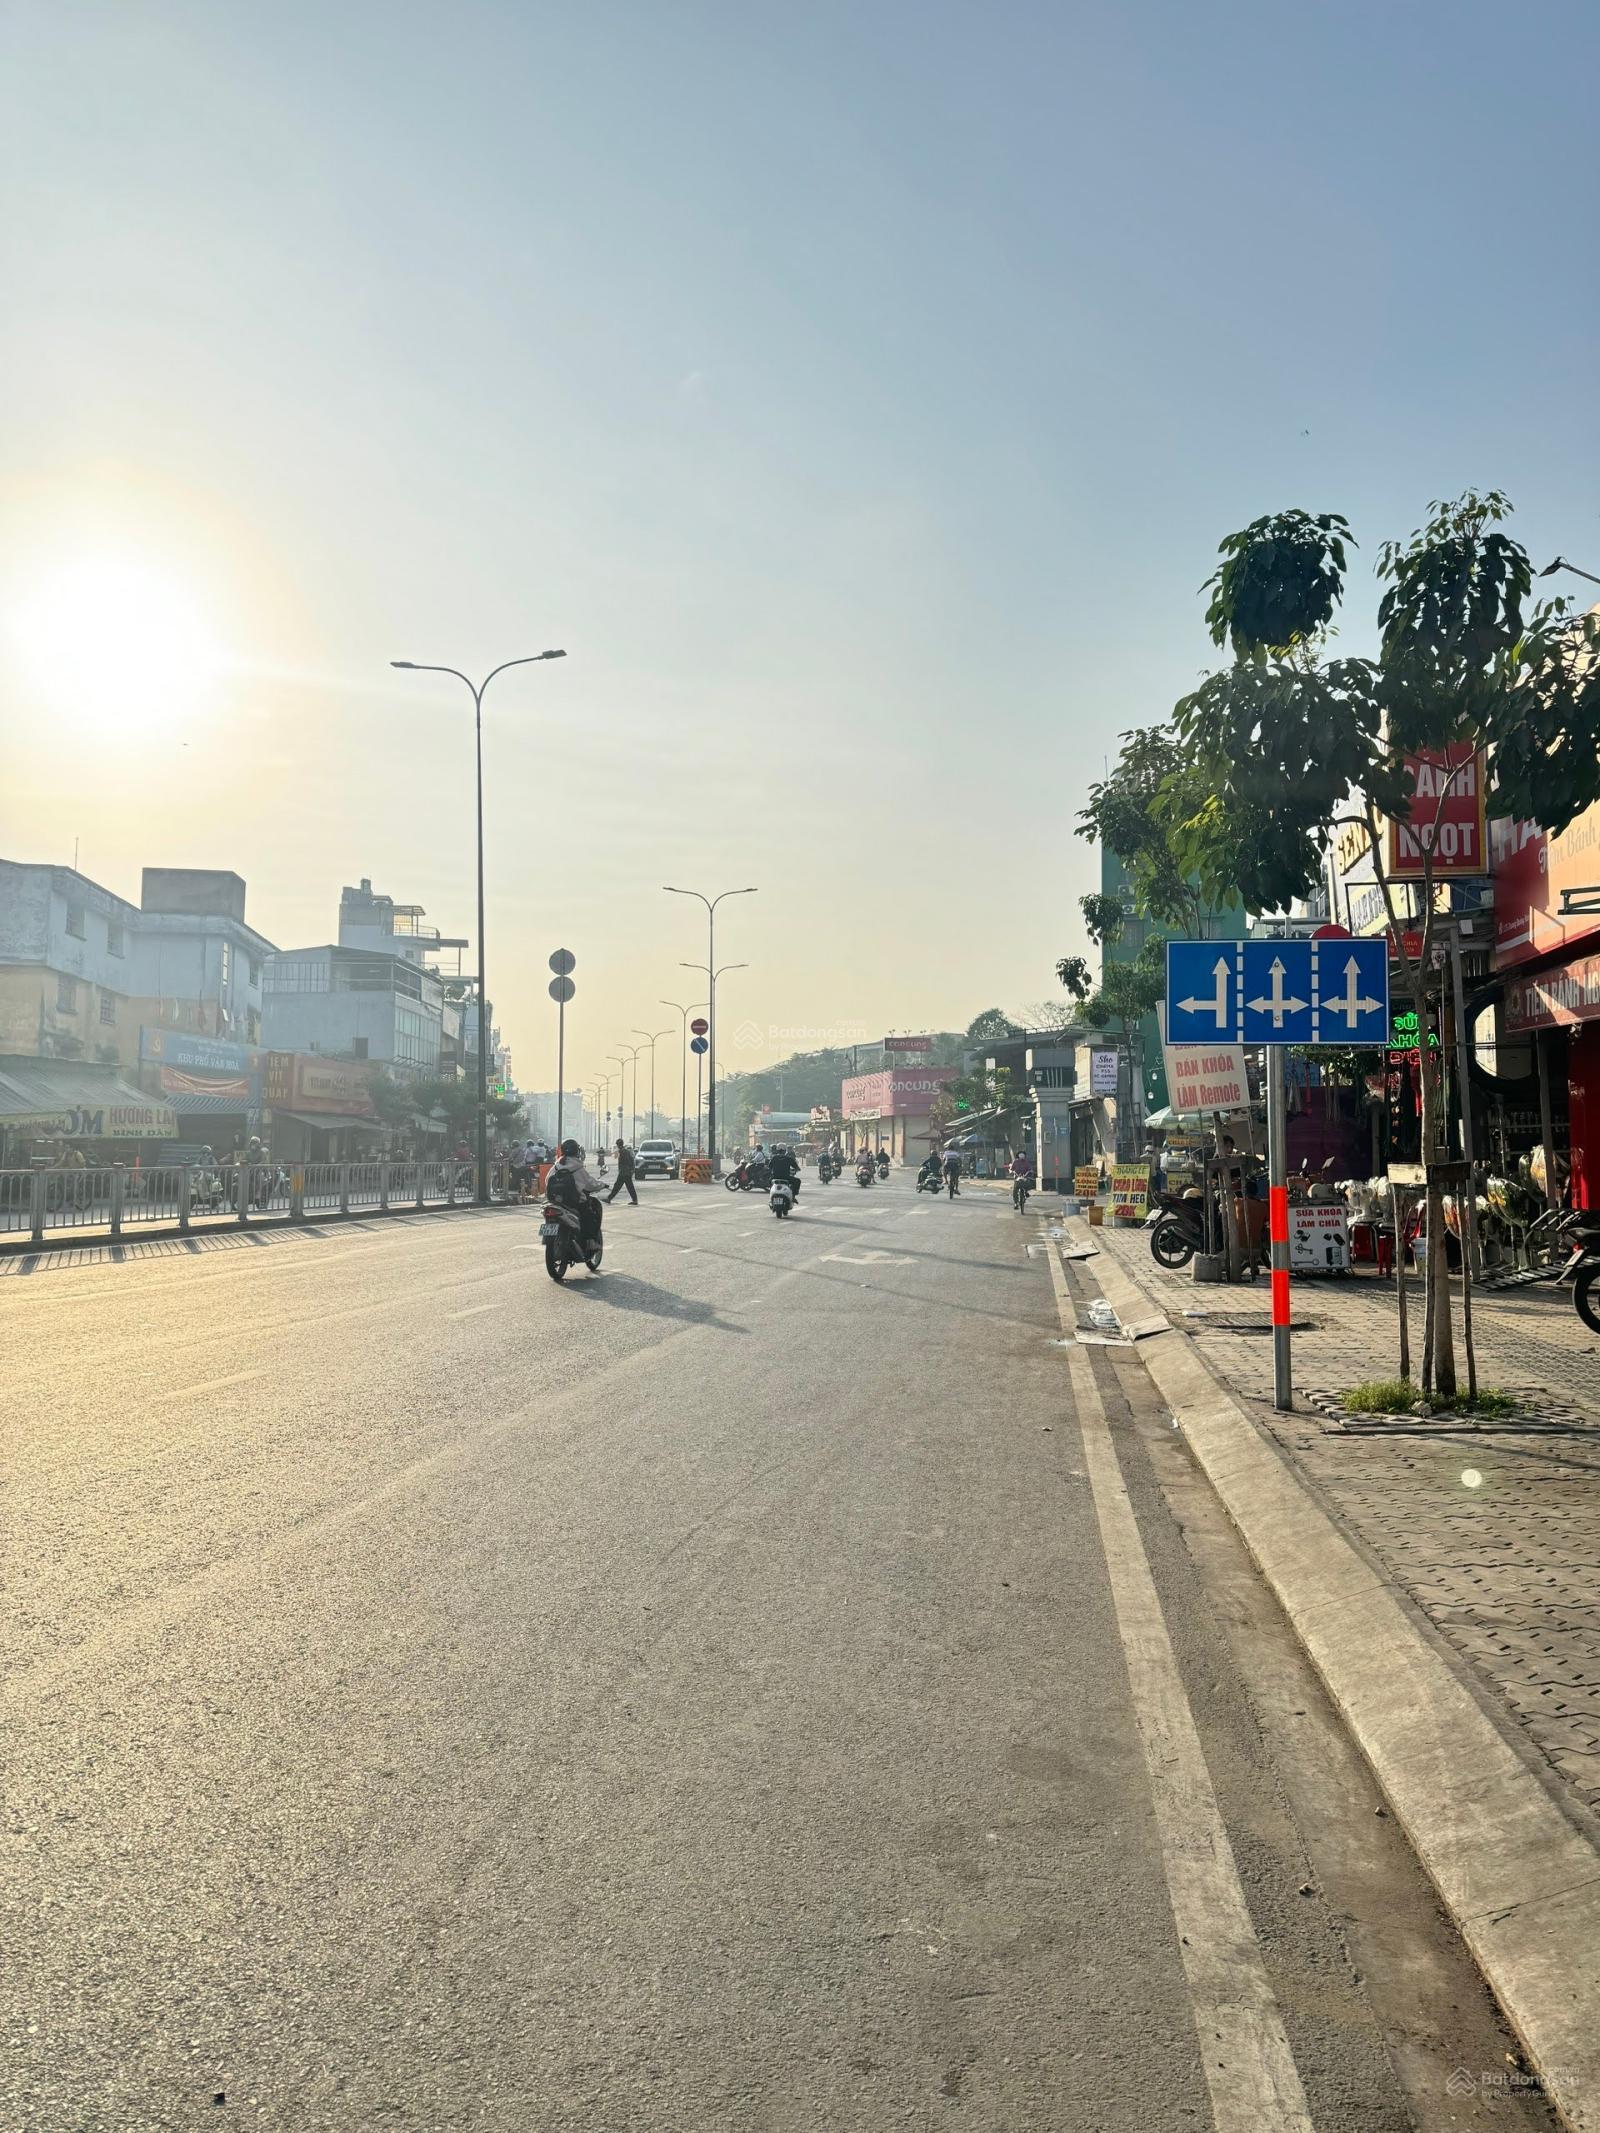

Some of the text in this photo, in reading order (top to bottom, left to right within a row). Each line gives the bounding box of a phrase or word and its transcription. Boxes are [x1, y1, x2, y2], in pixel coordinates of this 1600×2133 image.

[1402, 757, 1475, 798] ÁNH
[1551, 973, 1580, 1012] BÁNH
[1392, 1011, 1420, 1031] SỬ
[1175, 1053, 1234, 1077] BÁN KHÓA
[1176, 1082, 1241, 1108] LÀM Remote
